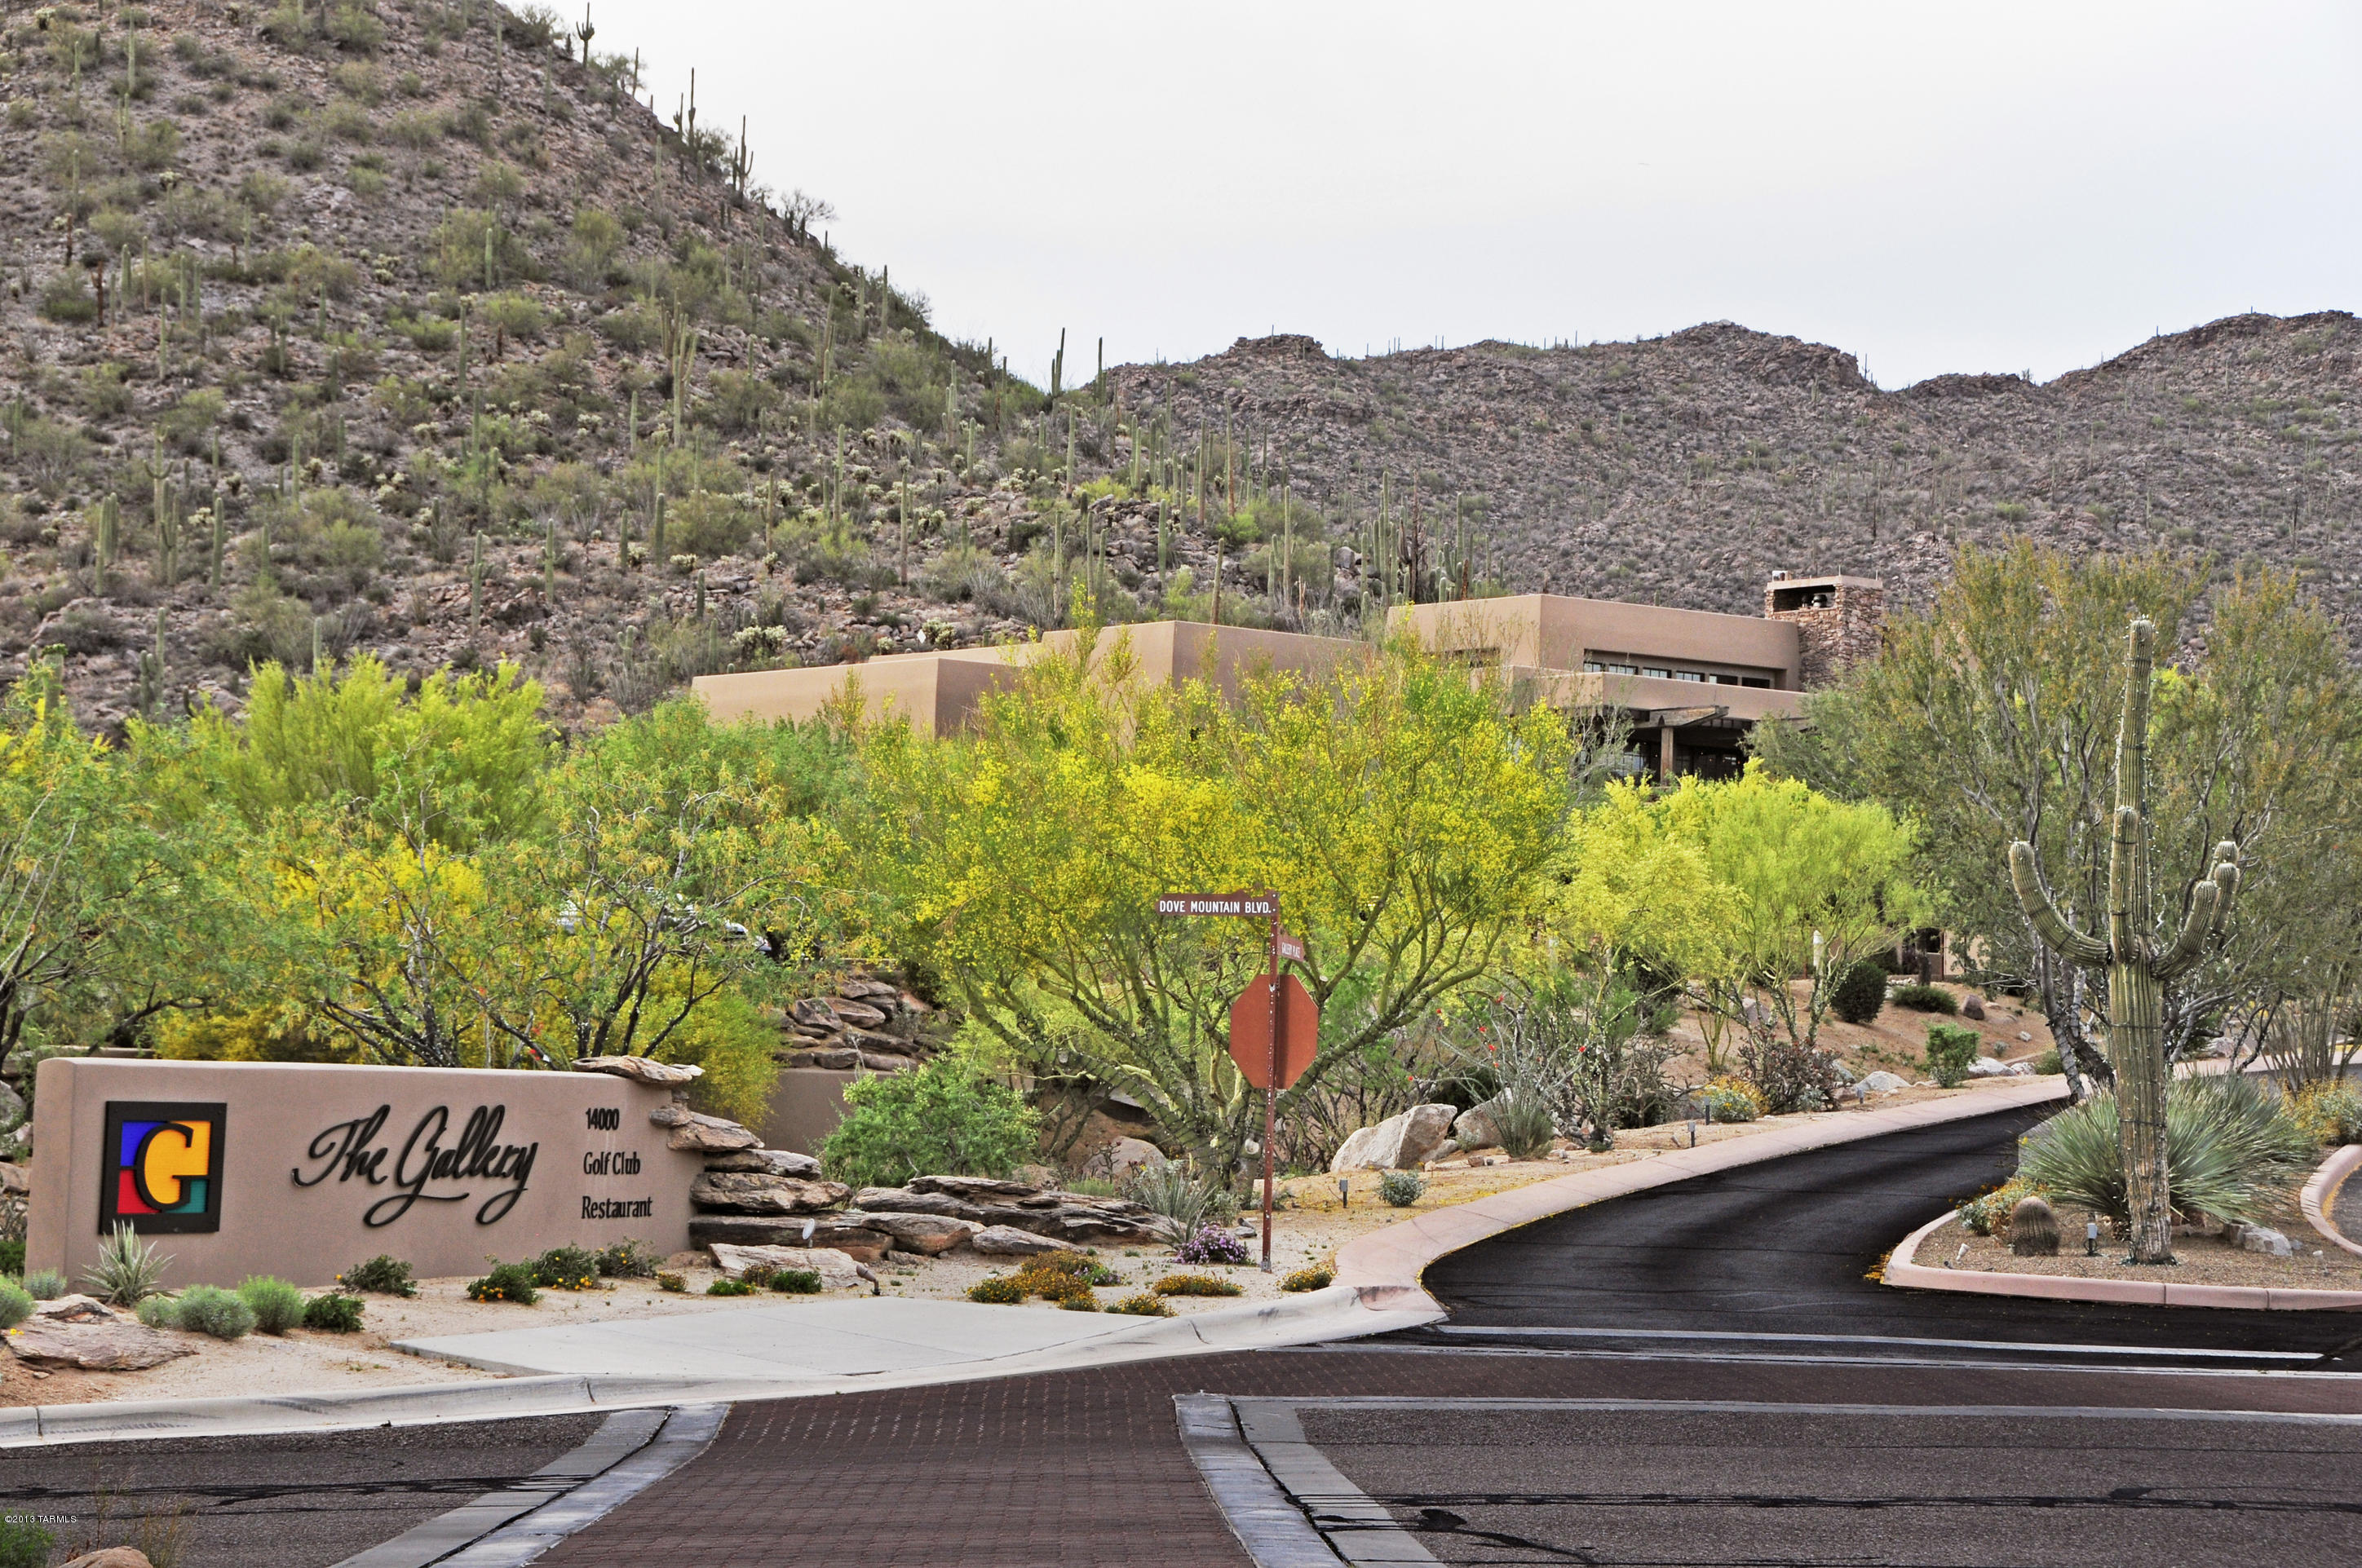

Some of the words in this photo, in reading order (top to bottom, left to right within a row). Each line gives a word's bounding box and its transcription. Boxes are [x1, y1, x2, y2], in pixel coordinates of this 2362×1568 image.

[1159, 900, 1186, 912] DOVE
[1190, 901, 1241, 913] MOUNTAIN
[1245, 902, 1272, 913] BLVD.
[585, 1107, 620, 1131] 14000
[134, 1122, 206, 1212] G
[290, 1104, 391, 1187] The
[363, 1104, 539, 1228] Gallery
[583, 1151, 611, 1175] Golf
[613, 1151, 641, 1175] Club
[581, 1195, 653, 1220] Restaurant
